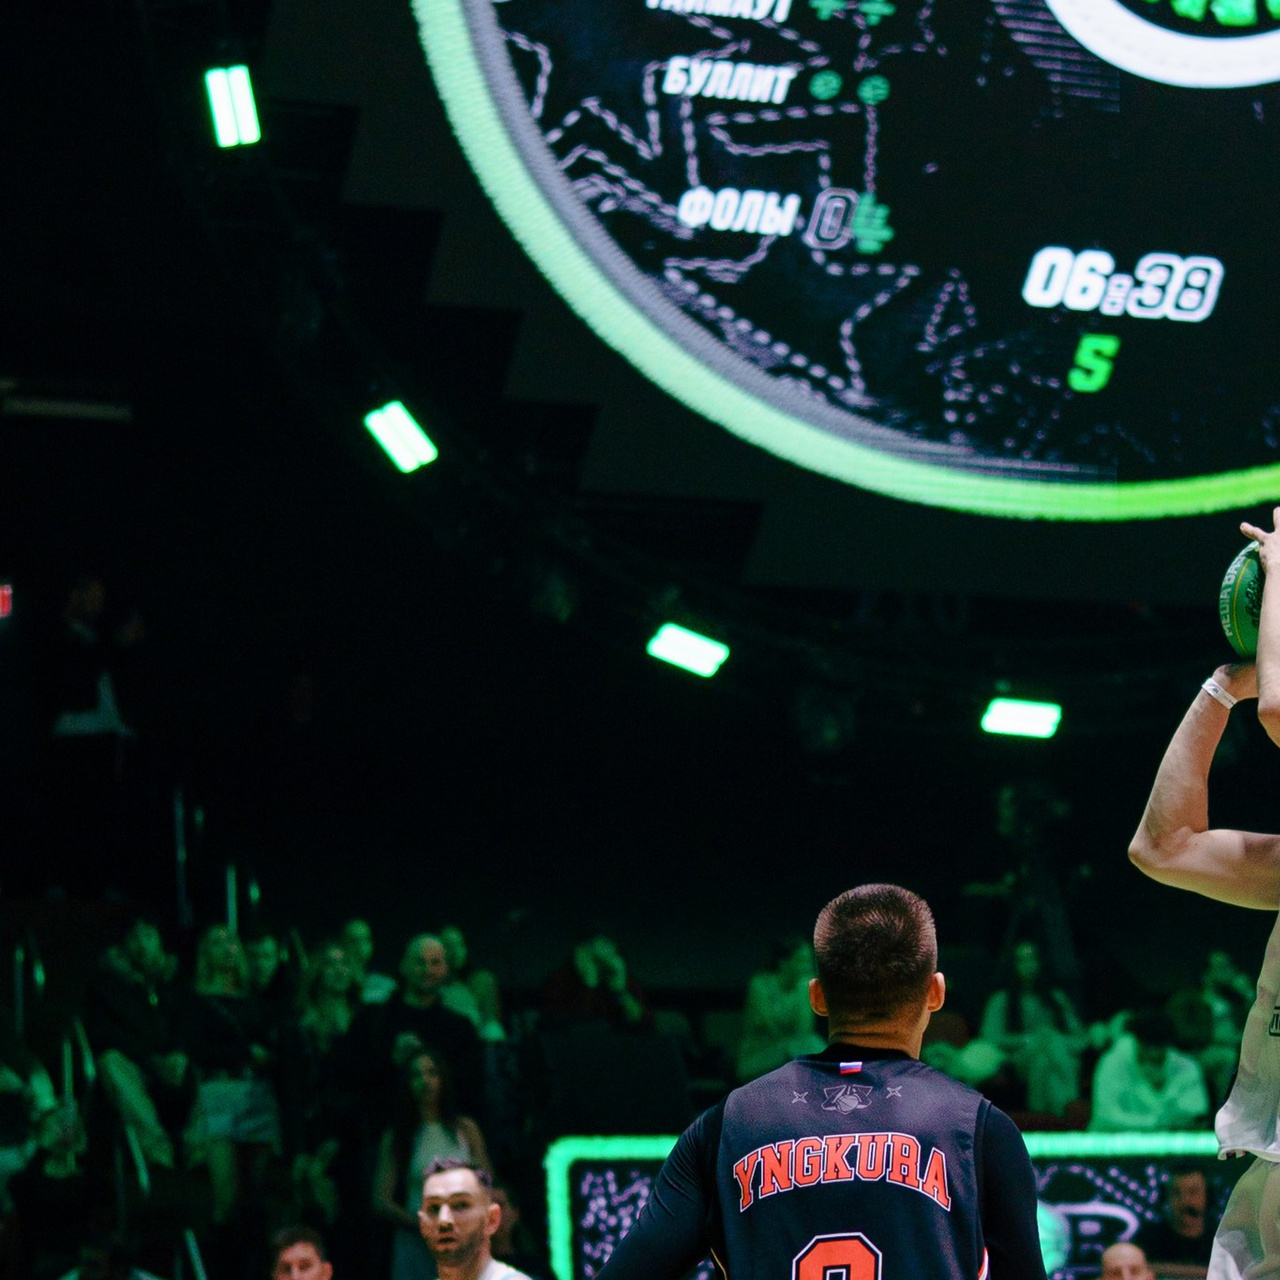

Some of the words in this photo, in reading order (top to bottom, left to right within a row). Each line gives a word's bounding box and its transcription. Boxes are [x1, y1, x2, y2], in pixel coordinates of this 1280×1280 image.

[662, 56, 798, 104] БУЛЛИТ
[677, 186, 800, 236] ФОЛЫ
[733, 1131, 952, 1213] YNGKURA
